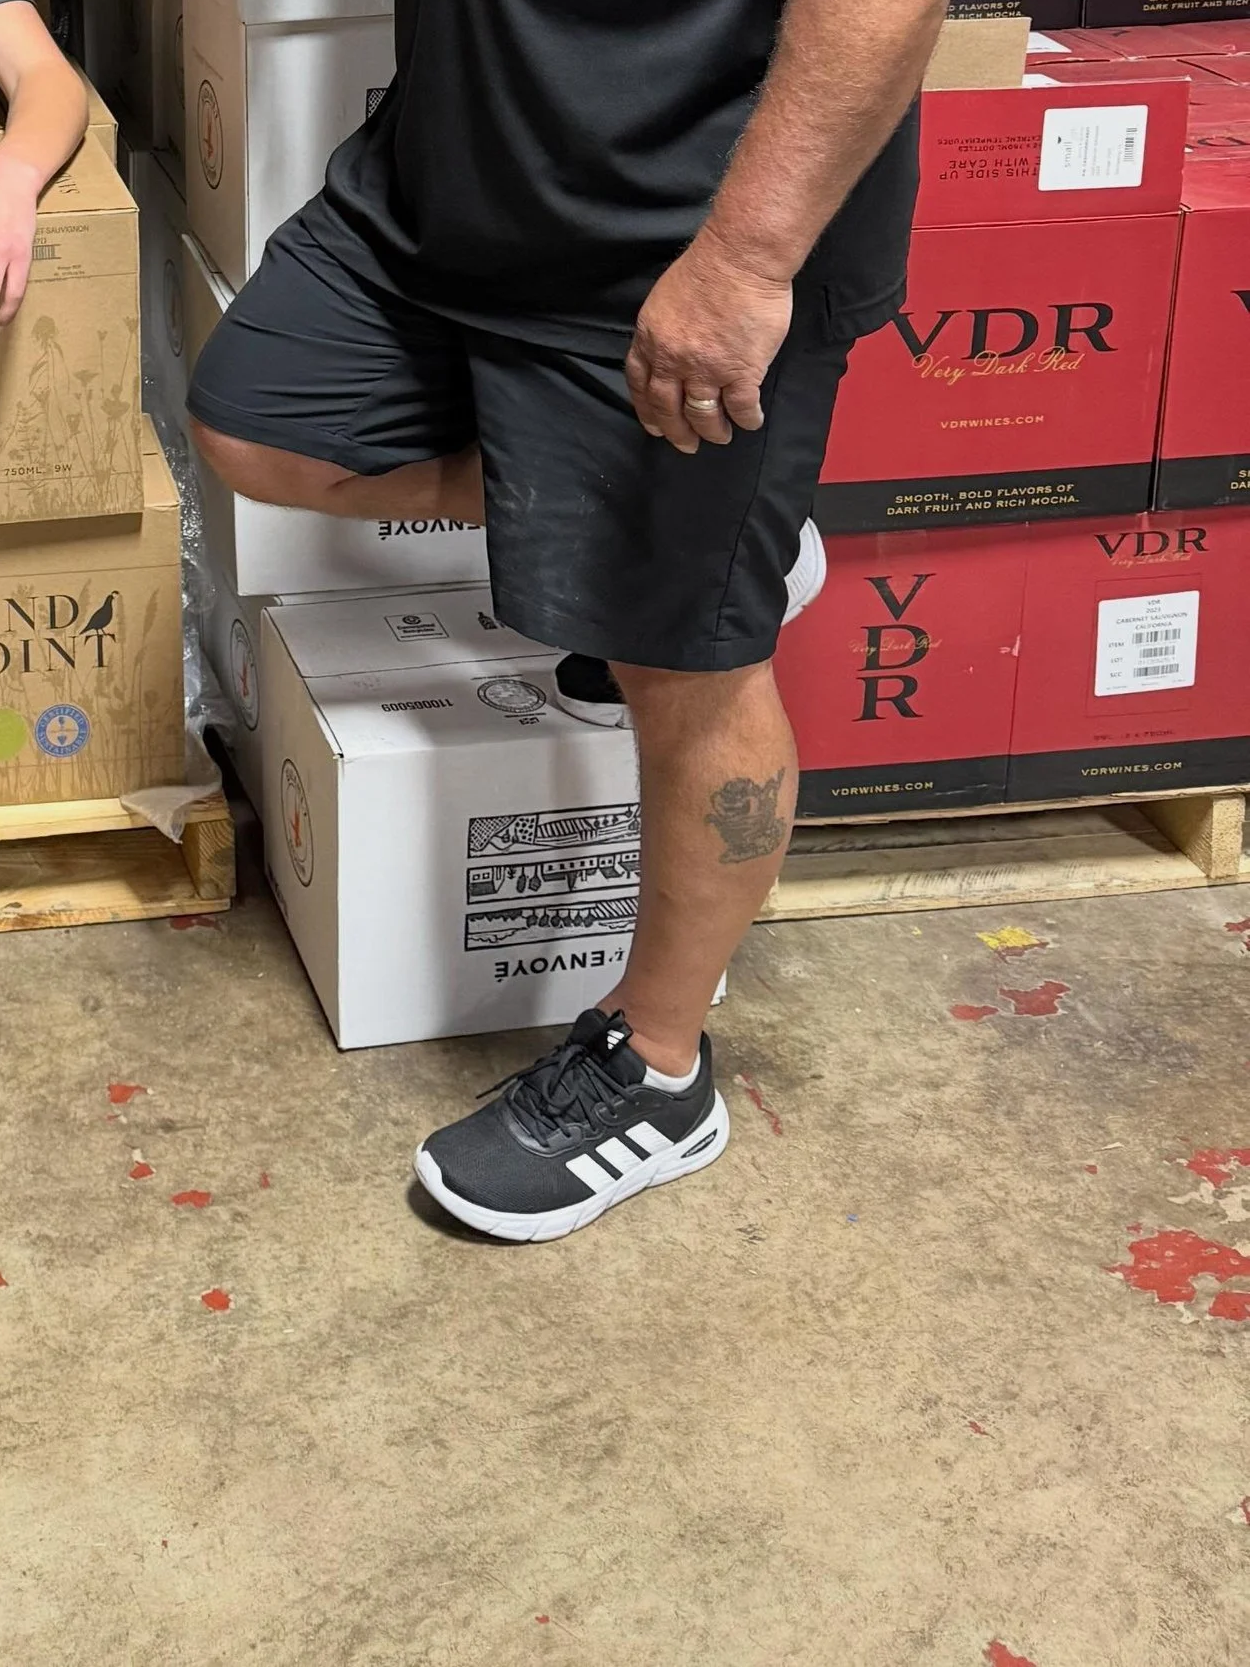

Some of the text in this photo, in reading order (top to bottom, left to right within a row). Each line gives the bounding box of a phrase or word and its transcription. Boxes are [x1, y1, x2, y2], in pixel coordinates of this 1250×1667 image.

[959, 1, 1021, 11] FLAVORS OF
[1143, 3, 1168, 12] DARK
[1172, 1, 1199, 10] FRUIT
[1202, 0, 1223, 9] AND
[949, 158, 1029, 169] WITH CARE
[939, 167, 1038, 180] THIS SIDE UP
[46, 225, 90, 234] SAUVIGNON
[892, 302, 1118, 362] VDR
[912, 345, 1086, 386] Very Dark Red
[940, 415, 1044, 429] VDRWINES.COM
[54, 464, 73, 473] 9W
[959, 490, 992, 500] BOLD
[997, 485, 1053, 497] FLAVORS
[1056, 484, 1075, 493] OF
[887, 494, 1080, 515] DARK FRUIT AND RICH MOCHA.
[1094, 527, 1210, 560] VDR
[1080, 760, 1182, 777] VDRWINES.COM
[832, 781, 934, 797] VDRWINES.COM
